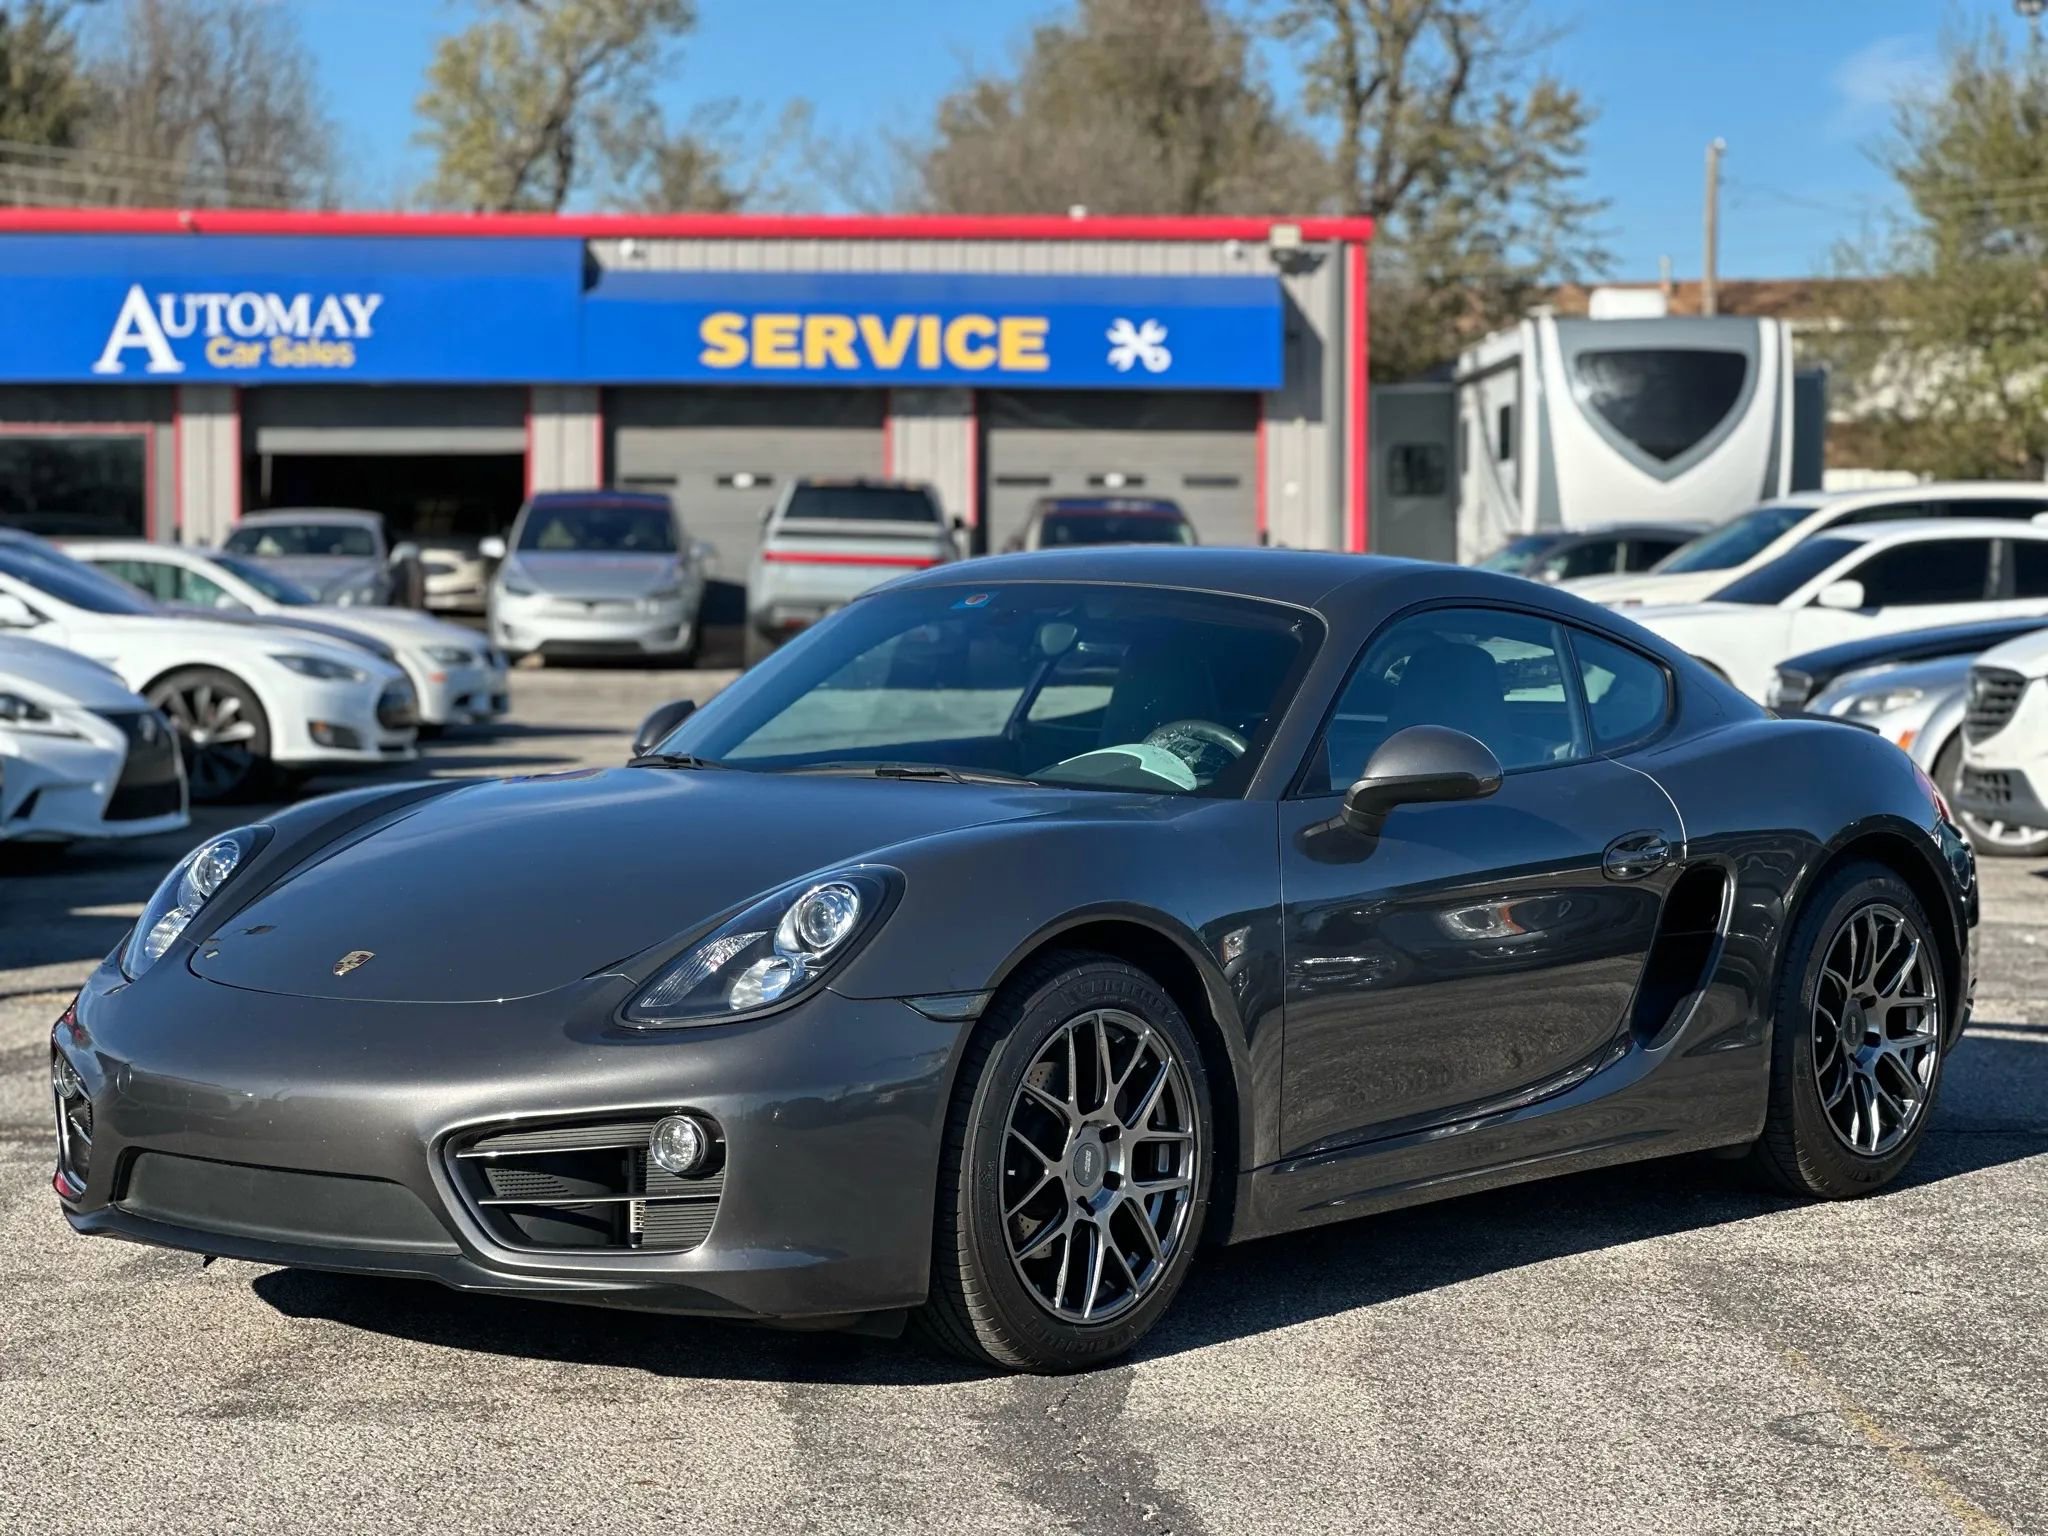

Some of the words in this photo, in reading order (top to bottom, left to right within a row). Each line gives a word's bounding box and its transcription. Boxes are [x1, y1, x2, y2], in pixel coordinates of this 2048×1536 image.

[92, 283, 383, 373] AUTOMAY
[205, 336, 266, 368] Car
[268, 337, 356, 368] Sales
[699, 312, 1050, 371] SERVICE
